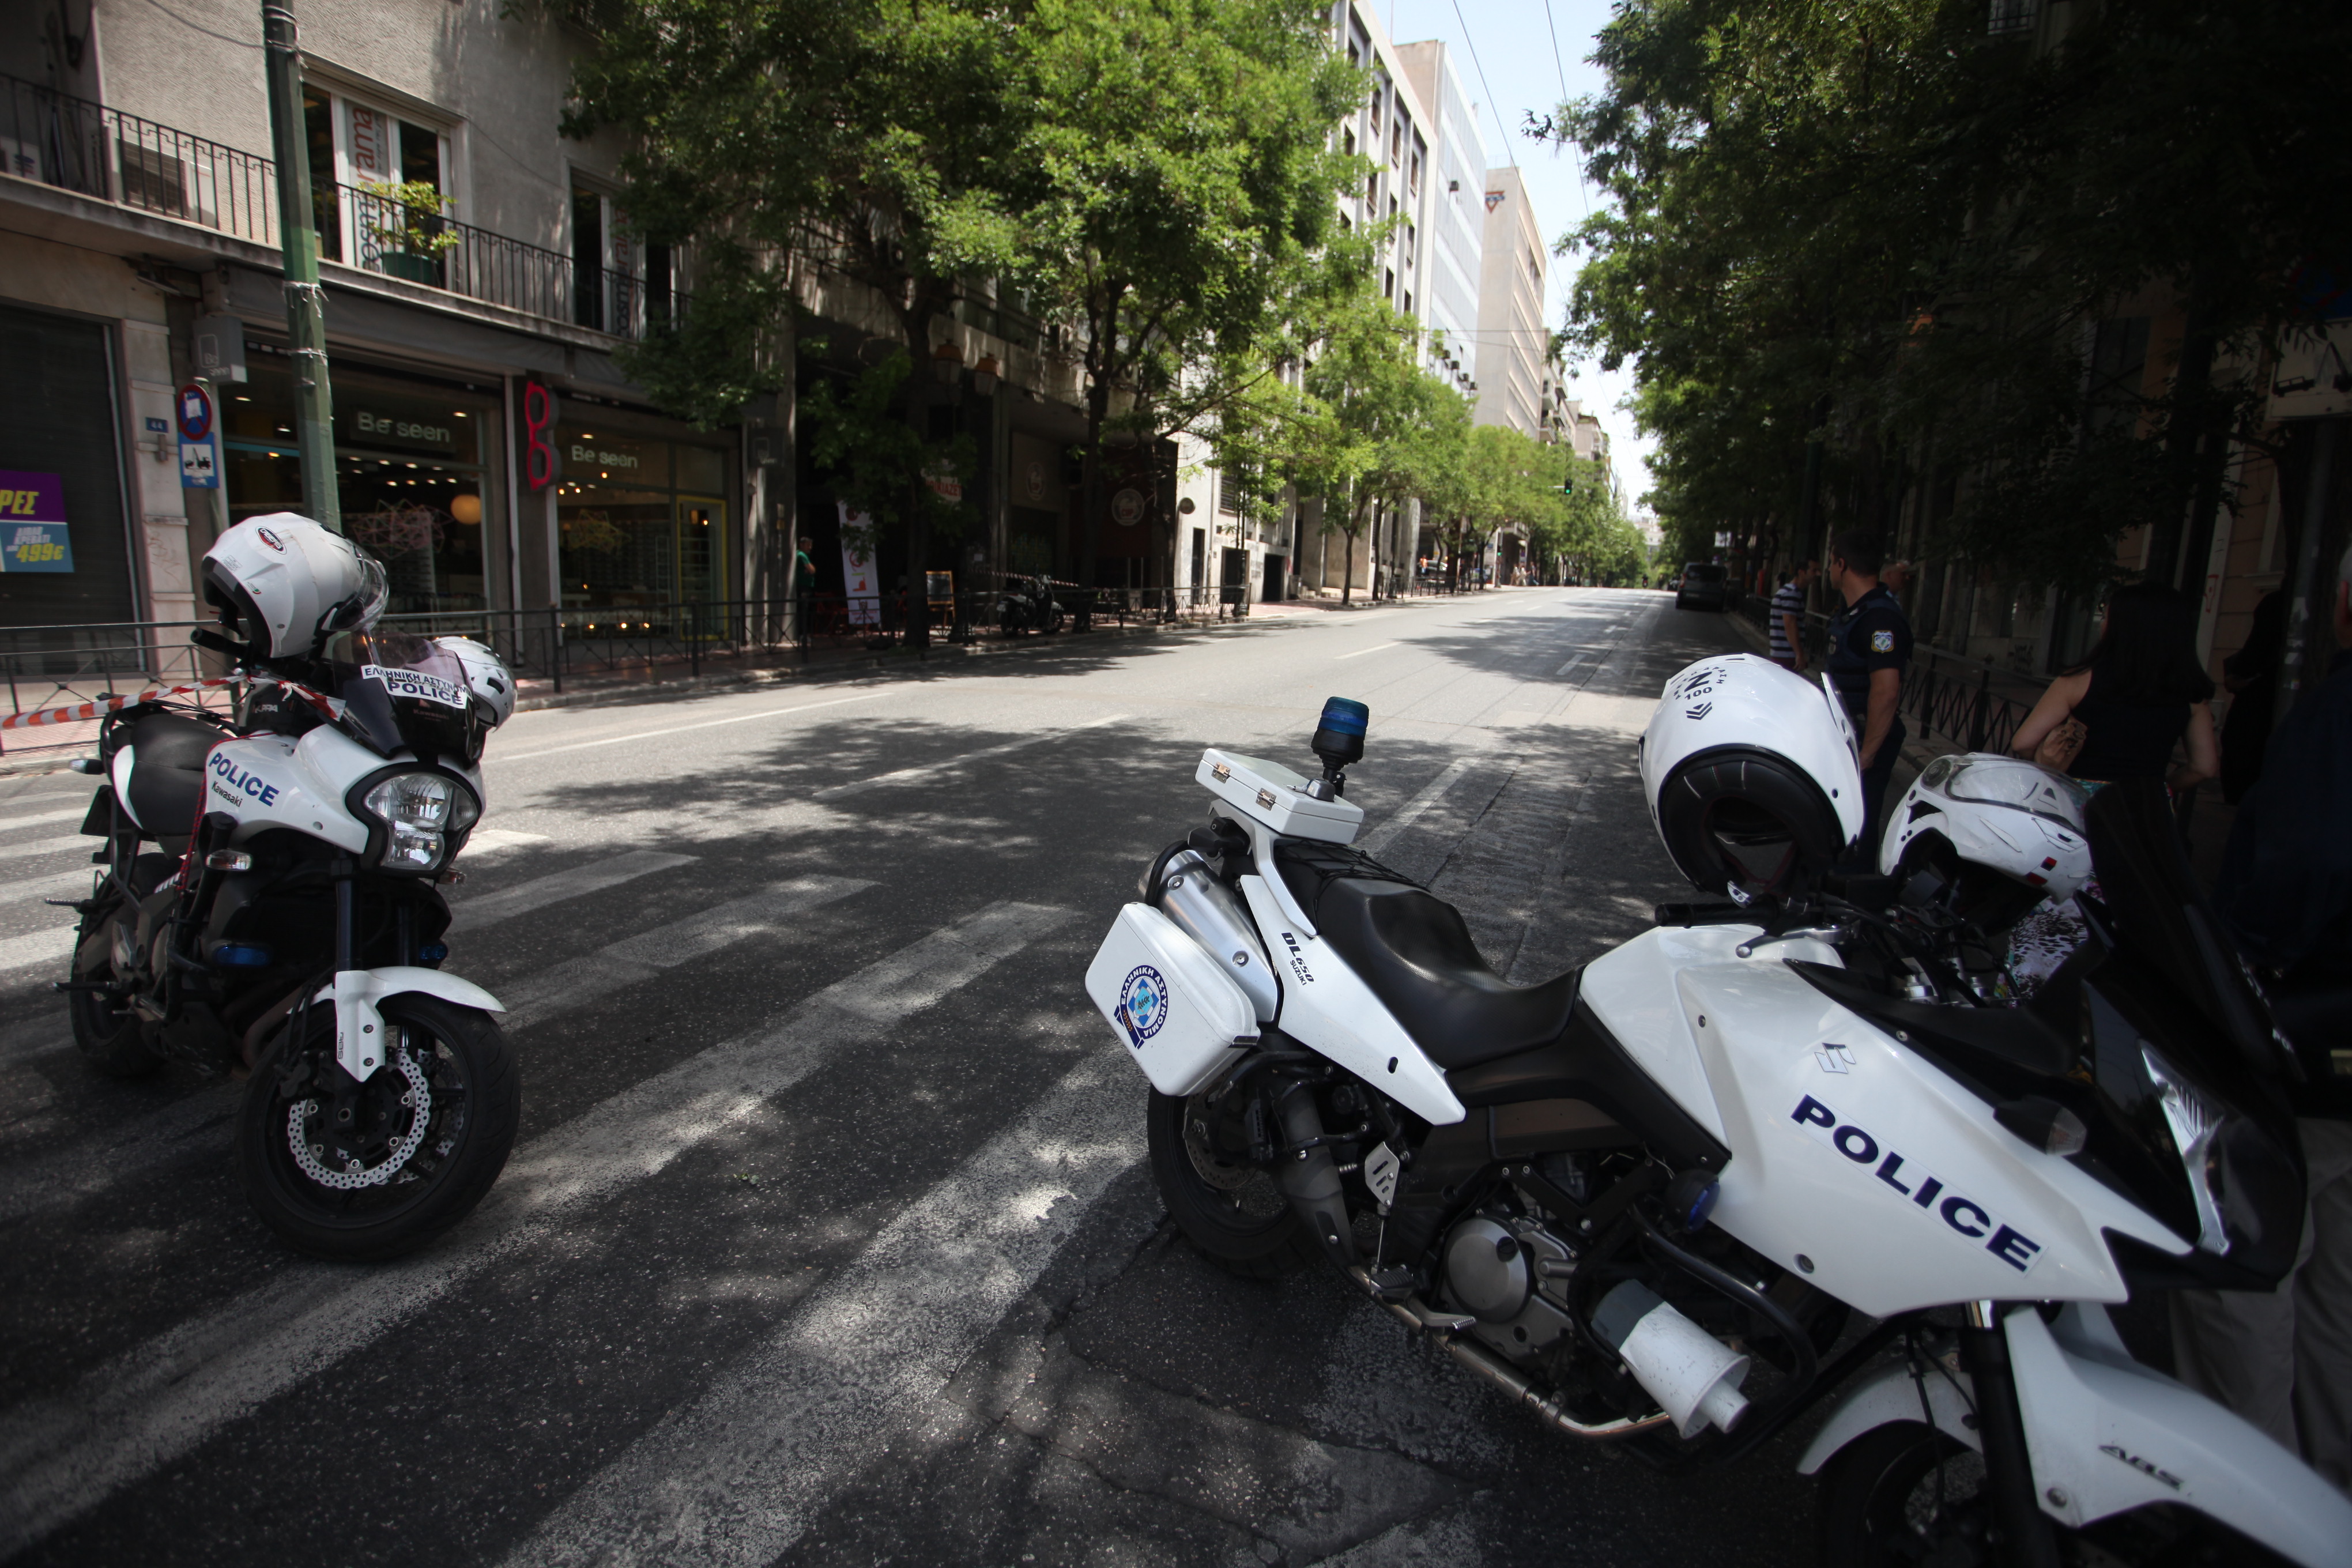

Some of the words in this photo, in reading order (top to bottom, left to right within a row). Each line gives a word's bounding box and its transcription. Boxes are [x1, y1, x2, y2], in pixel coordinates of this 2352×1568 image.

[352, 107, 380, 273] cosmrama
[150, 421, 163, 429] 44
[357, 411, 391, 435] Be
[396, 421, 450, 443] seen
[571, 444, 595, 463] Be
[598, 451, 638, 468] seen
[16, 543, 65, 563] 499€
[365, 667, 420, 682] ΕΛΛΗΝΙΚΗ
[387, 681, 464, 706] POLICE
[1684, 687, 1712, 700] 100
[209, 752, 280, 807] POLICE
[212, 781, 243, 808] Kawasaki
[1290, 959, 1307, 986] SUZUKI
[1121, 967, 1154, 1005] ΕΛΛΗΝΙΚΗ
[1143, 975, 1167, 1037] ΑΣΤΥΝΟΜΙΑ
[1791, 1094, 2041, 1273] POLICE
[2098, 1445, 2185, 1491] ABS
